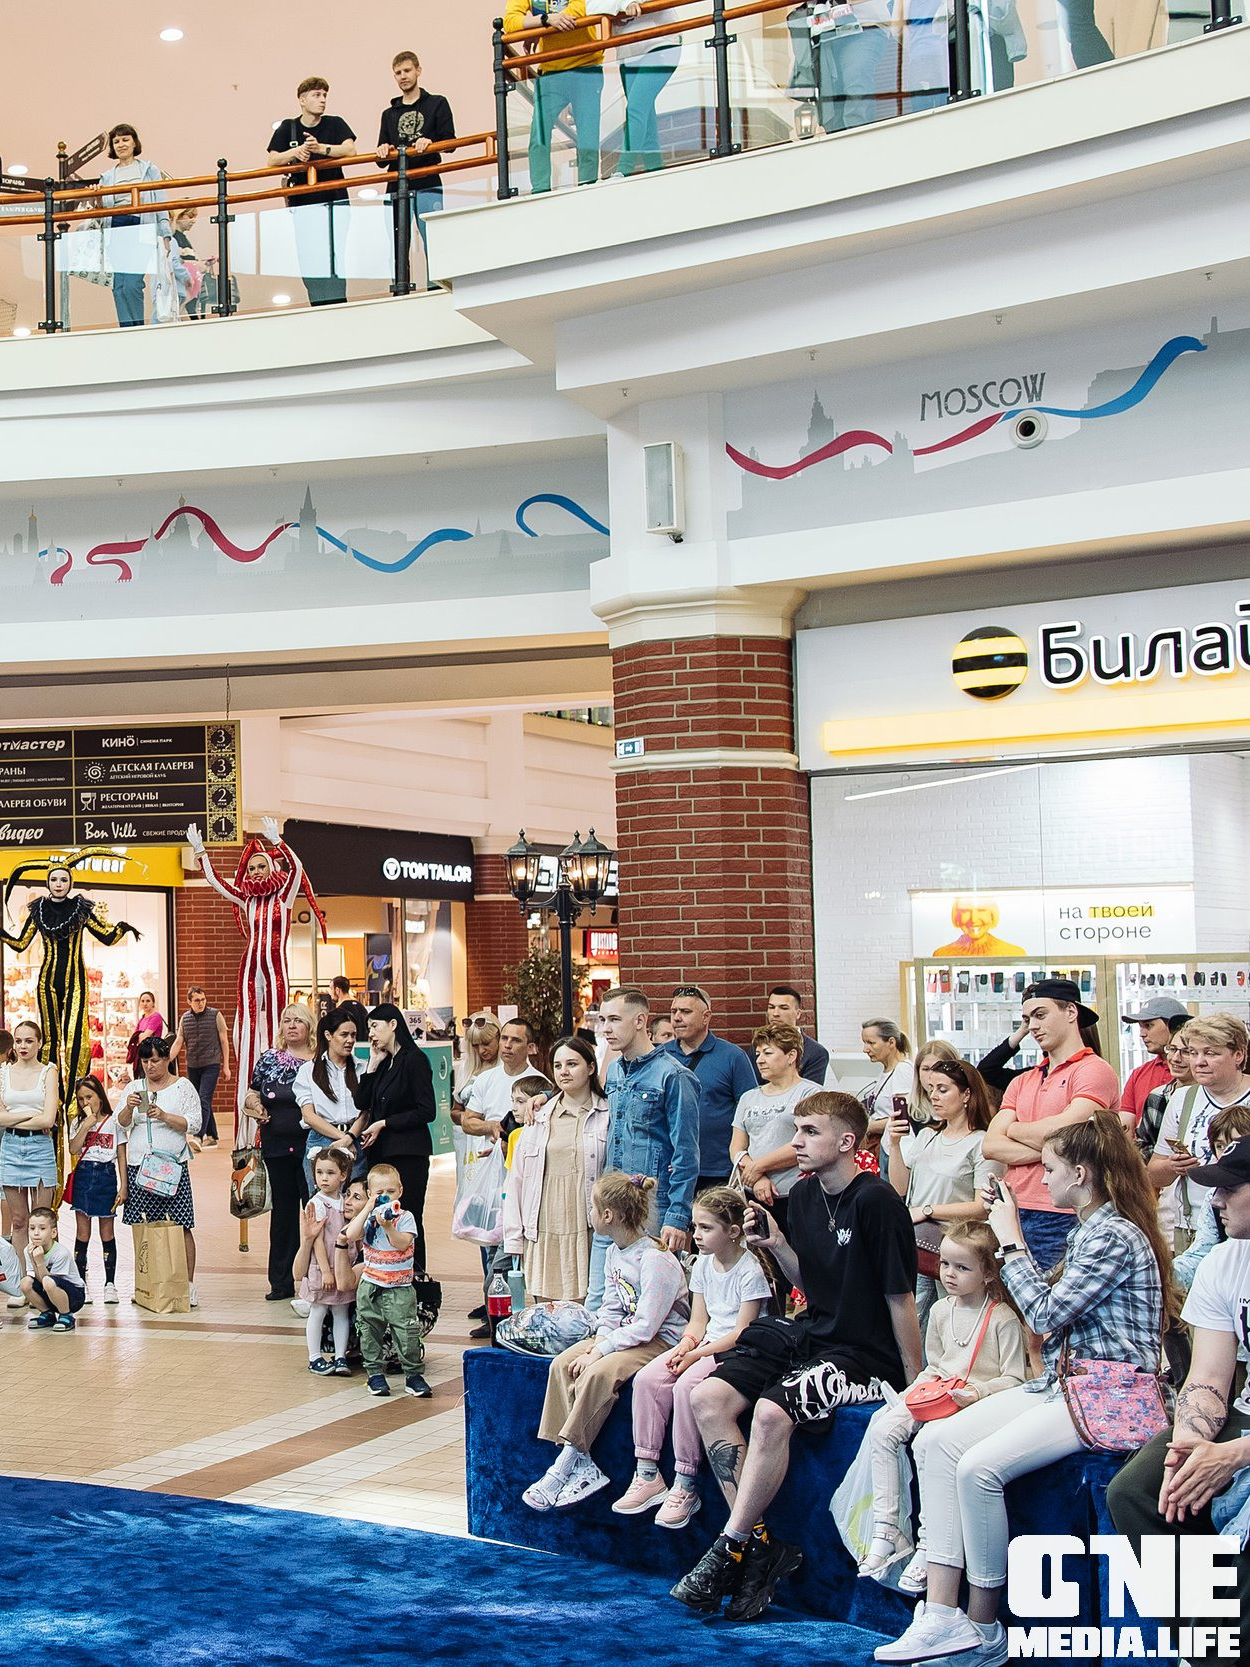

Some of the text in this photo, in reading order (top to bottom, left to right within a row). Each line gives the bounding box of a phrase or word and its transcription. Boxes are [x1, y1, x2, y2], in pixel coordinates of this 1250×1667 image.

[1, 178, 26, 187] ТОРАНЫ
[919, 371, 1046, 422] MOSCOW
[216, 729, 226, 744] 3
[109, 761, 194, 773] ДЕТСКАЯ ГАЛЕРЕЯ
[217, 758, 227, 773] 3
[33, 798, 67, 807] ОБУВИ
[100, 792, 159, 802] РЕСТОРАНЫ
[218, 788, 227, 802] 2
[84, 821, 138, 840] Bon Ville
[218, 817, 226, 832] 1
[166, 829, 188, 837] ПРОДУ
[400, 861, 472, 883] TOM TAILOR
[1058, 901, 1154, 919] на твоей
[1058, 924, 1152, 944] стороне
